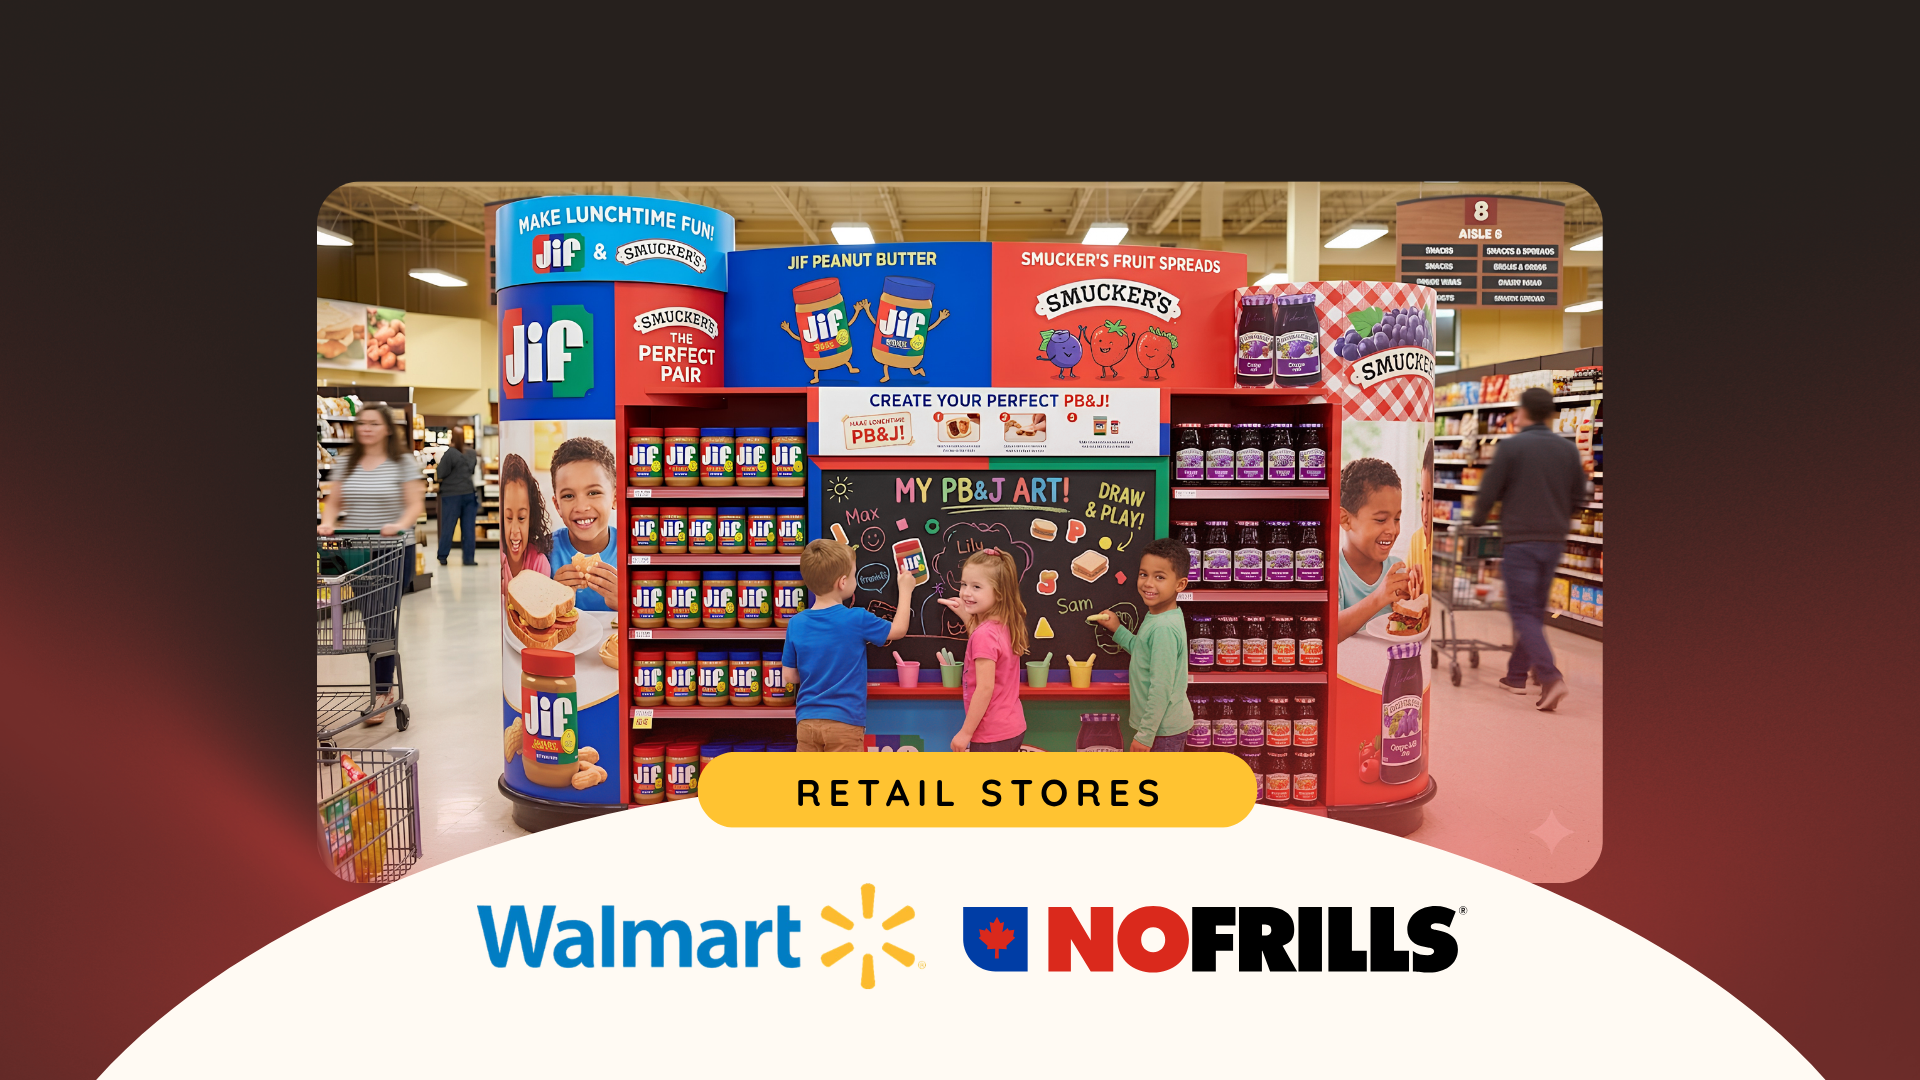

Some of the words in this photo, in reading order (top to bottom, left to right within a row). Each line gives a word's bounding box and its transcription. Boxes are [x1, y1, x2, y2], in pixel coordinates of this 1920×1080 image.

[1474, 200, 1489, 222] 8
[519, 208, 562, 234] MAKE
[566, 206, 676, 229] LUNCHTIME
[682, 216, 715, 241] FUN!
[1458, 229, 1492, 239] AISLE
[536, 238, 581, 268] Jif
[594, 243, 607, 260] &
[624, 243, 702, 268] SMUCKER'S
[788, 255, 808, 270] JIF
[812, 253, 872, 268] PEANUT
[876, 252, 937, 267] BUTTER
[1021, 252, 1109, 268] SMUCKER'S
[1113, 254, 1156, 269] FRUIT
[1159, 256, 1221, 273] SPREADS
[1046, 283, 1172, 314] SMUCKER'S
[641, 310, 715, 334] SMUCKER'S
[802, 309, 843, 343] Jif
[879, 309, 926, 339] Jif
[670, 332, 693, 344] THE
[505, 320, 584, 385] Jif
[639, 344, 716, 365] PERFECT
[661, 366, 701, 382] PAIR
[870, 394, 932, 407] CREATE
[937, 394, 982, 407] YOUR
[987, 394, 1059, 408] PERFECT
[1064, 394, 1110, 408] PB&J!
[852, 425, 905, 444] PB&J!
[630, 446, 659, 466] Jif
[666, 446, 696, 466] Jif
[702, 446, 732, 466] Jif
[736, 446, 765, 466] Jif
[772, 446, 802, 466] Jif
[896, 477, 932, 503] MY
[942, 477, 1006, 503] PB&J
[1013, 477, 1070, 503] ART!
[1099, 482, 1146, 508] DRAW
[846, 508, 879, 526] Max
[1085, 501, 1097, 518] &
[1100, 504, 1145, 530] PLAY!
[1066, 519, 1086, 543] P
[632, 588, 662, 608] Jif
[667, 588, 697, 608] Jif
[703, 588, 732, 608] Jif
[738, 588, 768, 608] Jif
[775, 588, 804, 608] Jif
[1057, 598, 1093, 614] Sam
[634, 668, 662, 687] Jif
[667, 668, 695, 687] Jif
[698, 668, 724, 687] Jif
[730, 668, 757, 687] Jif
[524, 695, 573, 738] Jif
[633, 765, 662, 784] Jif
[667, 765, 696, 784] Jif
